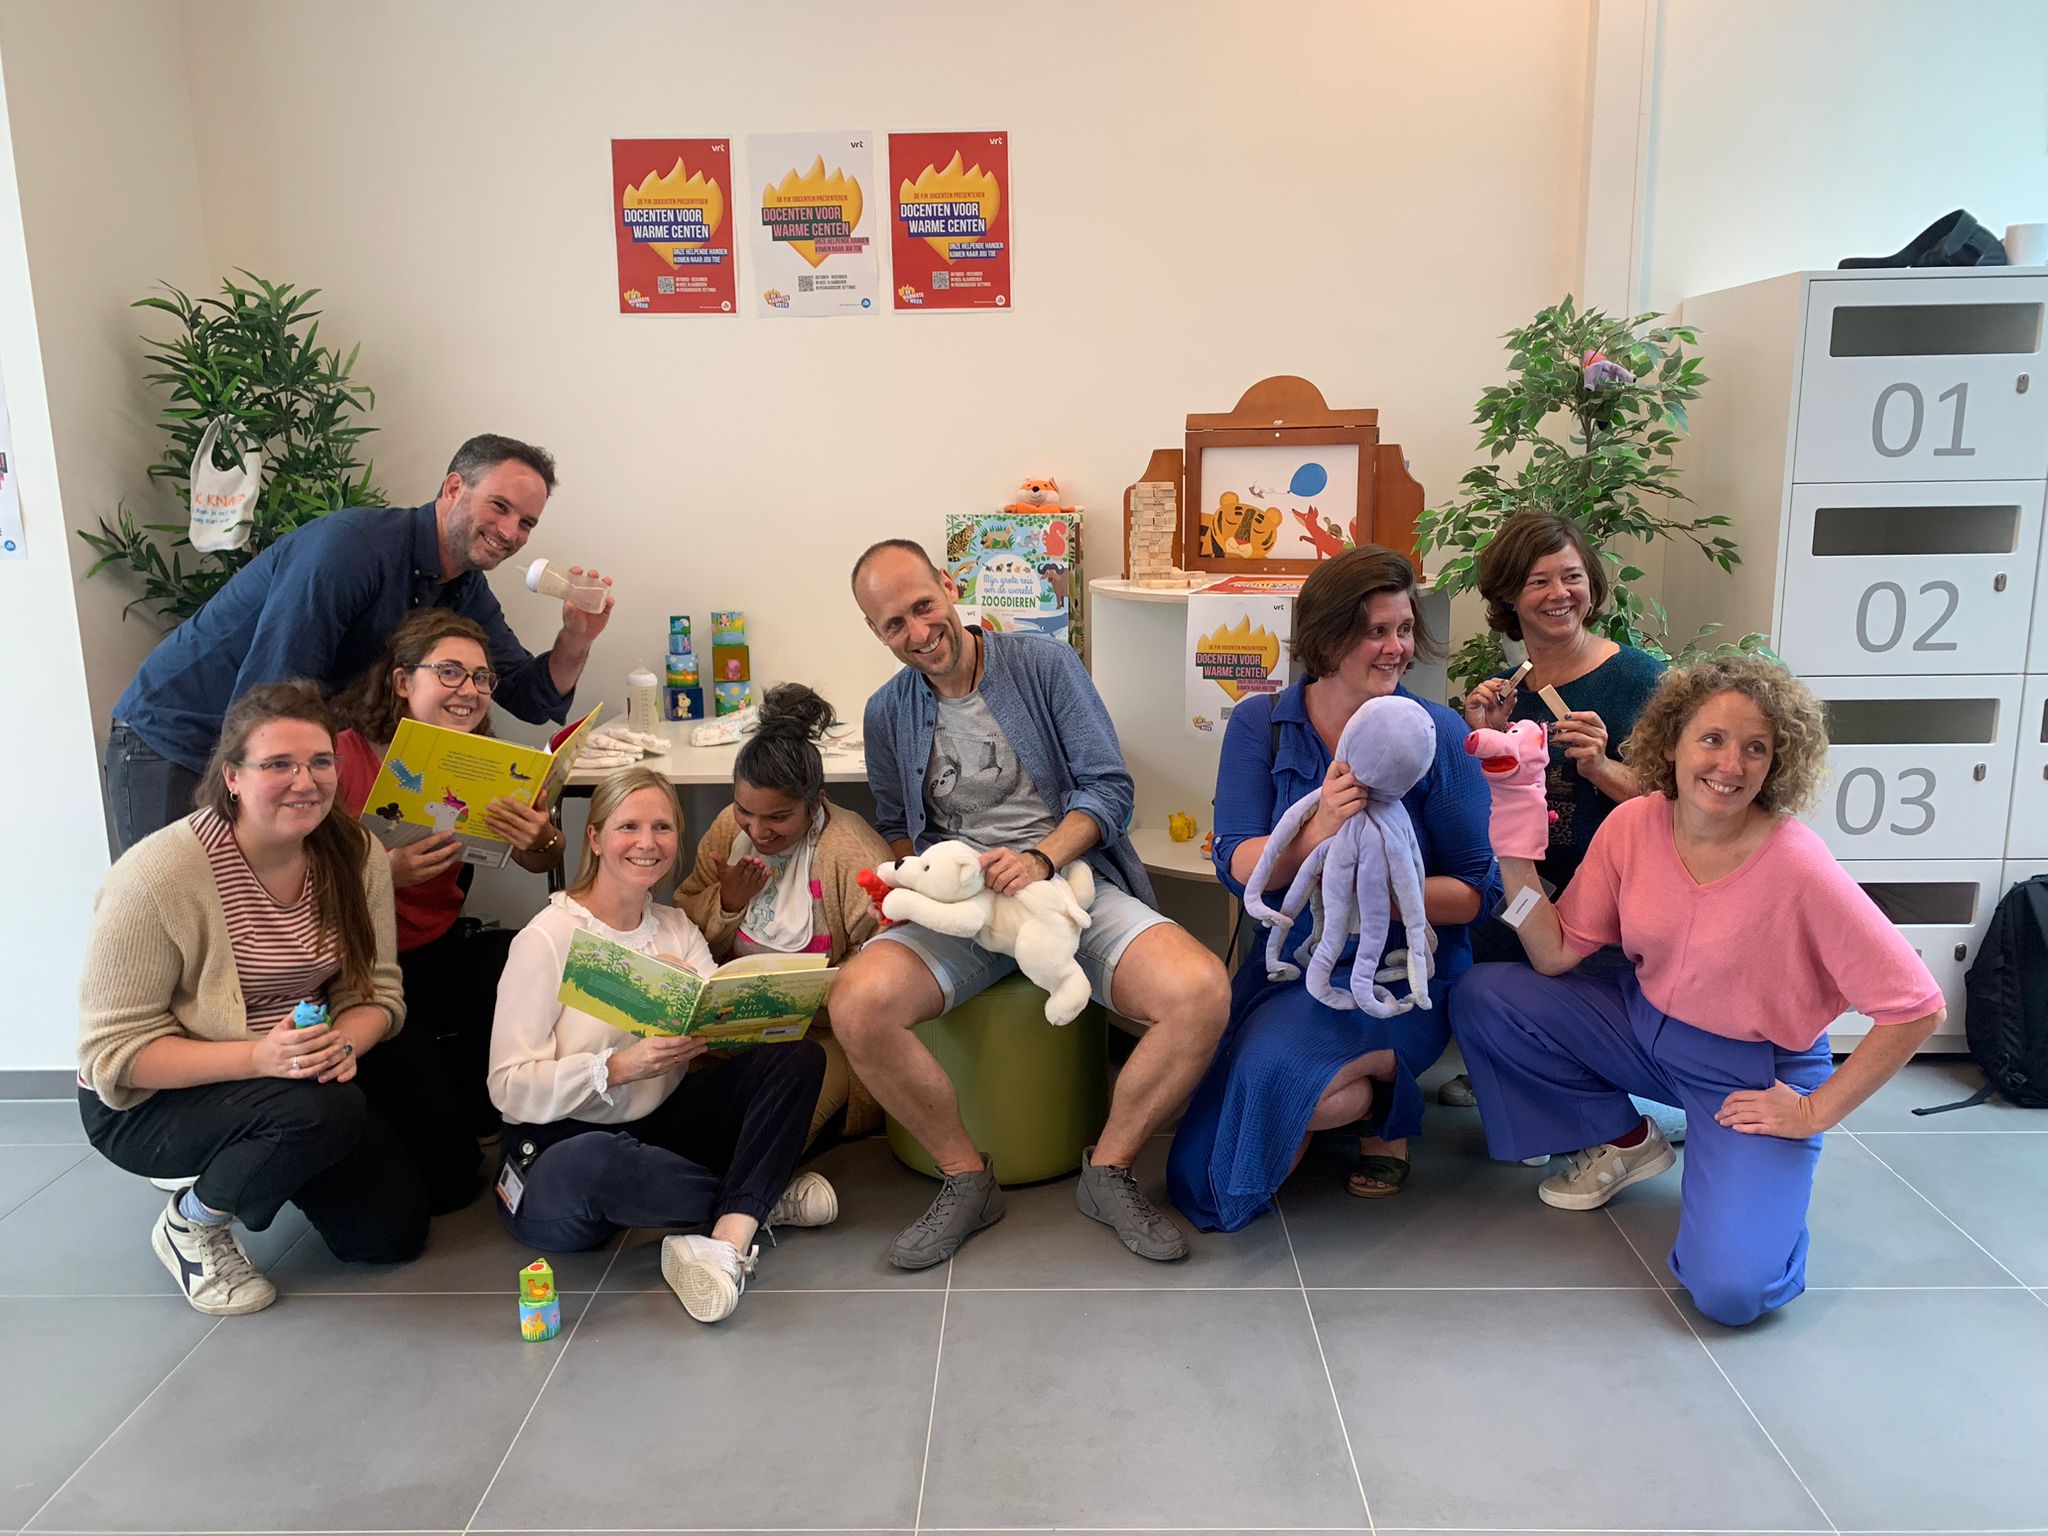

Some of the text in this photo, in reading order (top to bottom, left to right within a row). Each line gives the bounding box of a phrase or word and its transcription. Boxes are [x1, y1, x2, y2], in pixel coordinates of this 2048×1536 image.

[624, 209, 702, 222] DOCENTEN VOOR
[763, 207, 841, 221] DOCENTEN VOOR
[901, 203, 978, 217] DOCENTEN VOOR
[633, 225, 709, 238] WARME CENTEN
[773, 223, 849, 236] WARME CENTEN
[909, 219, 985, 233] WARME CENTEN
[1871, 381, 1976, 458] 01
[1000, 576, 1019, 587] grote
[1008, 586, 1034, 594] wereld
[982, 596, 1035, 608] ZOOGDIEREN
[1855, 579, 1960, 654] 02
[1197, 654, 1260, 664] DOCENTEN VOOR
[1204, 667, 1266, 678] WARME CENTEN
[1835, 766, 1937, 836] 03
